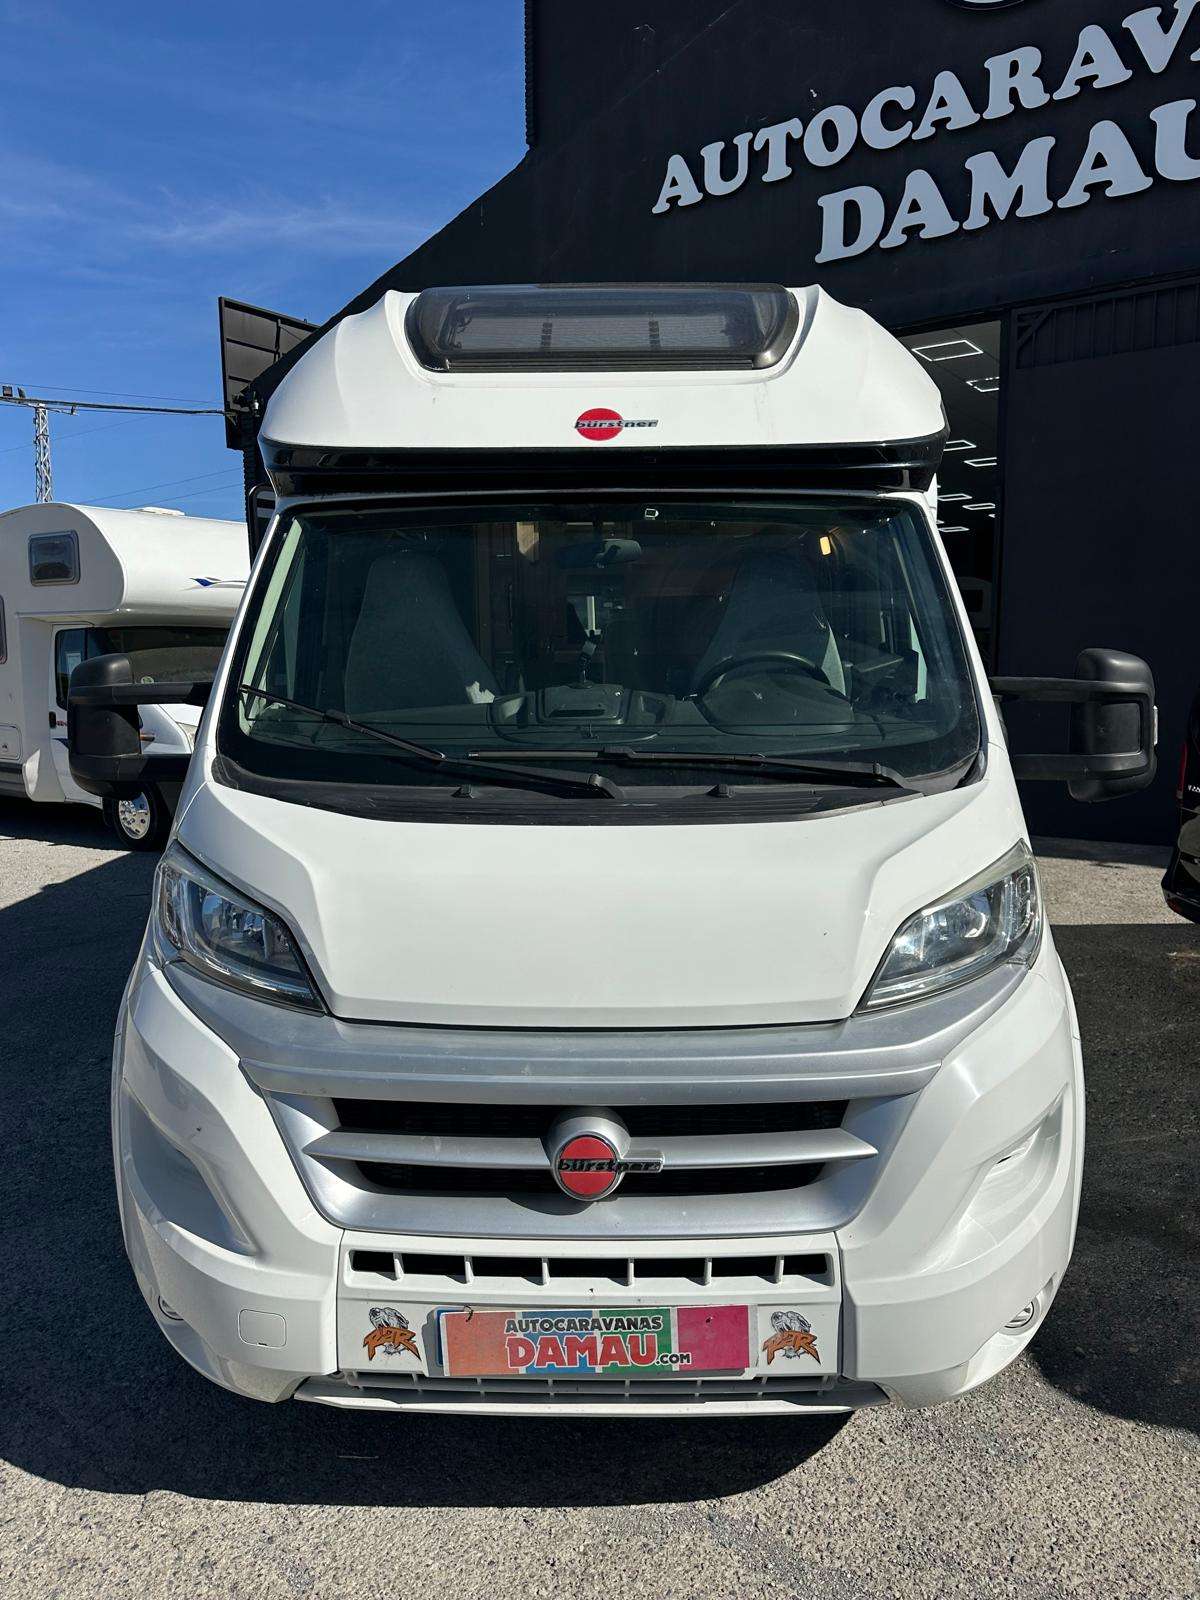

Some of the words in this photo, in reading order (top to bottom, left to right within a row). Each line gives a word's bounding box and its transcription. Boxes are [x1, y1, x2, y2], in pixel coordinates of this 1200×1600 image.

[652, 0, 1200, 214] AUTOCARAV
[814, 98, 1200, 264] DAMAU
[574, 418, 658, 429] bürstner
[504, 1315, 663, 1334] AUTOCARAVANAS
